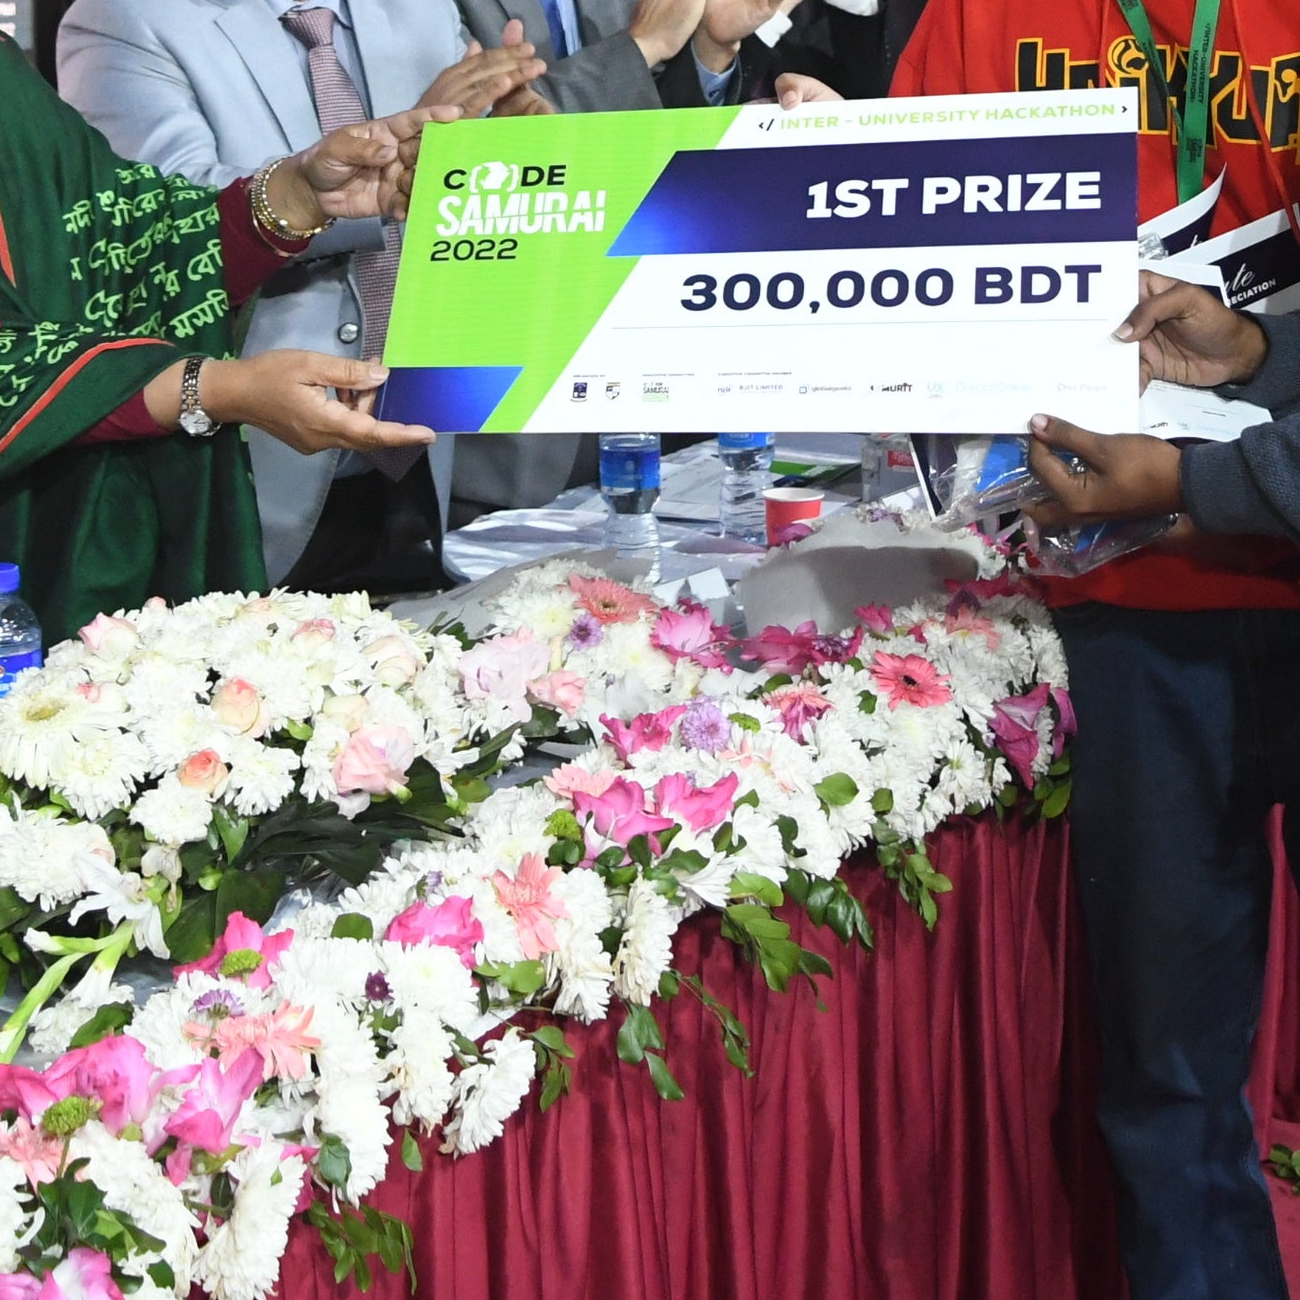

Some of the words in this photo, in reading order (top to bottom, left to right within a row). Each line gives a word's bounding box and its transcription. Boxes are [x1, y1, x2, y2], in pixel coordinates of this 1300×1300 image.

[780, 116, 839, 130] INTER
[859, 108, 980, 126] UNIVERSITY
[985, 103, 1116, 119] HACKATHON
[435, 190, 607, 237] SAMURAI
[806, 178, 909, 219] 1ST
[922, 171, 1102, 215] PRIZE
[430, 238, 518, 262] 2022
[680, 267, 954, 314] 300,000
[974, 264, 1102, 305] BDT
